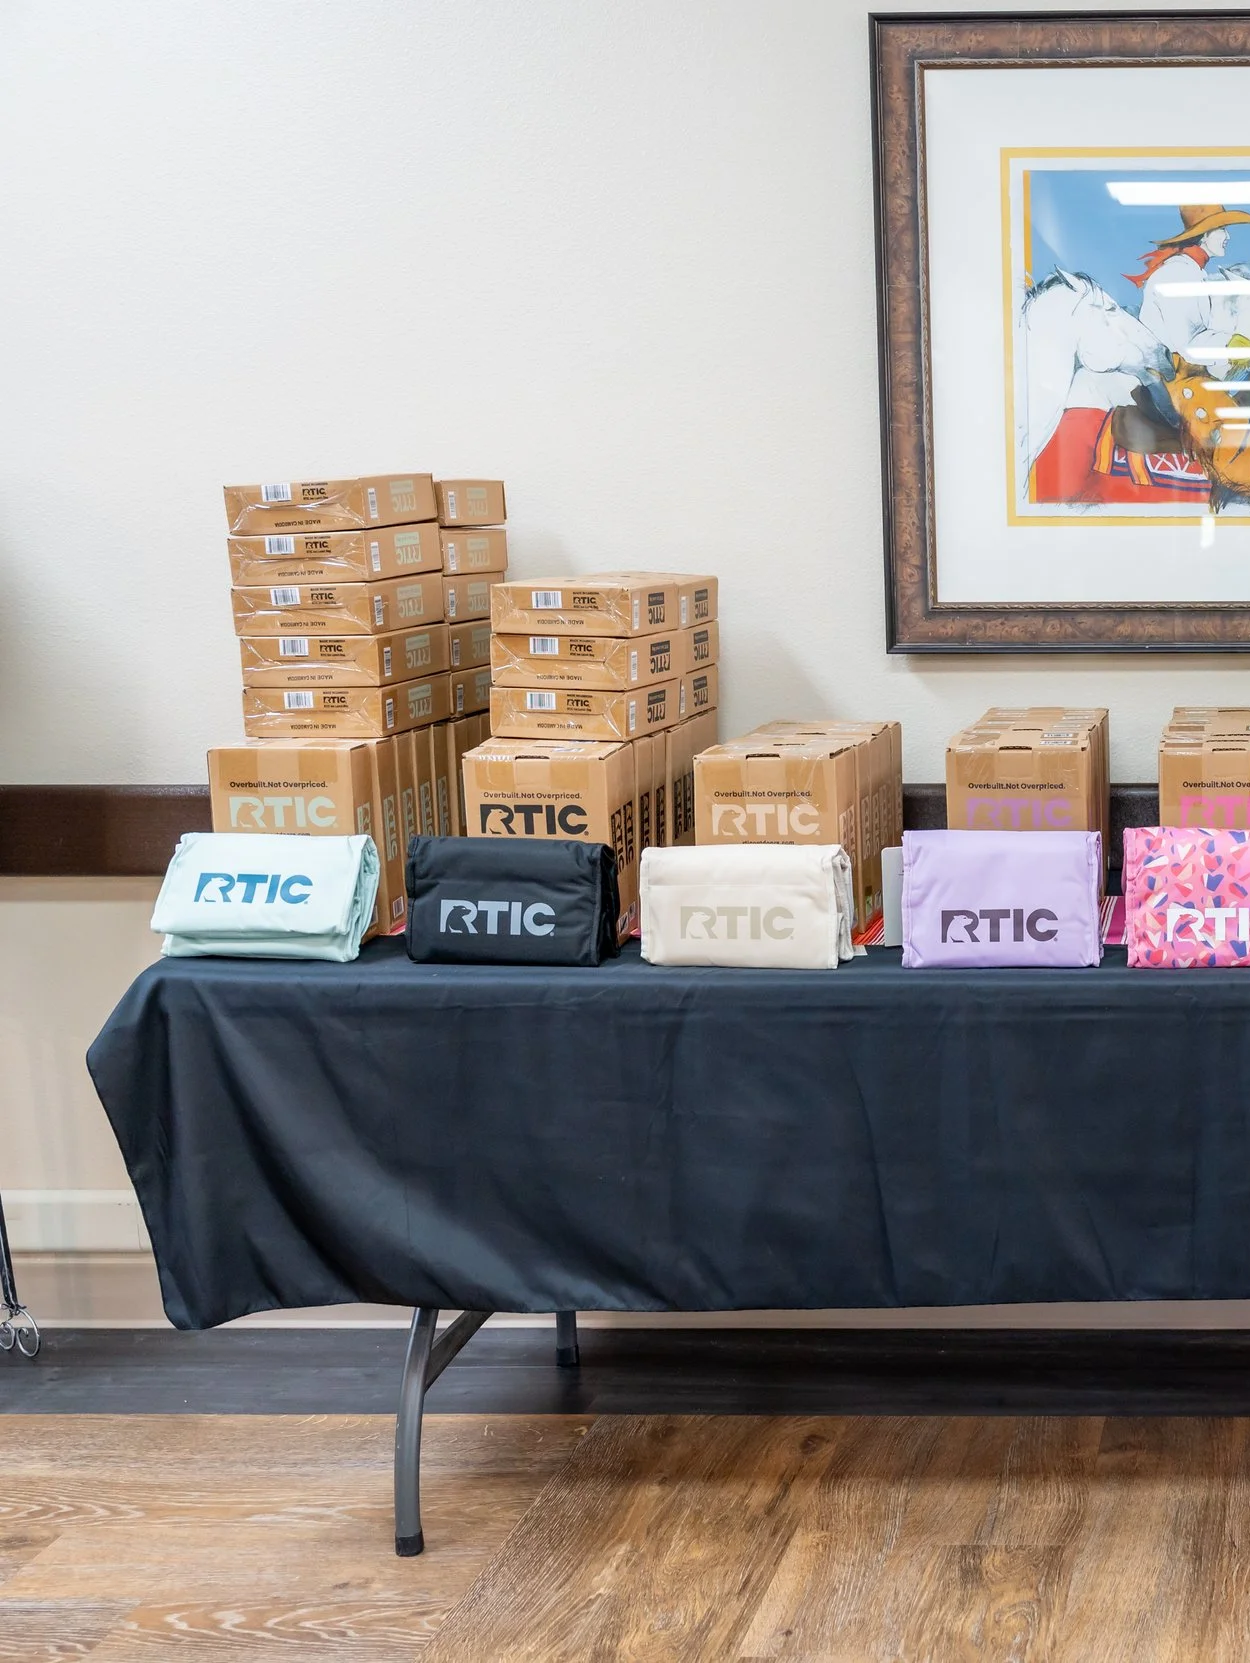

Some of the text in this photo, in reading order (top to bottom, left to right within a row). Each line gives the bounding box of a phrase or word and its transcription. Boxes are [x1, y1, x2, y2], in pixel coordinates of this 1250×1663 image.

[302, 487, 326, 496] RTIC
[305, 541, 329, 549] RTIC
[311, 592, 335, 601] RTIC
[573, 596, 597, 605] RTIC
[319, 645, 343, 653] RTIC
[569, 643, 593, 652] RTIC
[323, 696, 346, 704] RTIC
[567, 699, 590, 707] RTIC
[282, 781, 328, 790] Overpriced.
[1020, 782, 1066, 791] Overpriced.
[536, 791, 583, 800] Overpriced.
[229, 796, 338, 829] RTIC
[967, 796, 1073, 829] RTIC
[480, 804, 589, 836] RTIC
[712, 803, 820, 836] RTIC
[193, 872, 314, 905] RTIC
[439, 898, 556, 937] RTIC
[680, 905, 796, 940] RTIC
[940, 908, 1059, 943] RTIC
